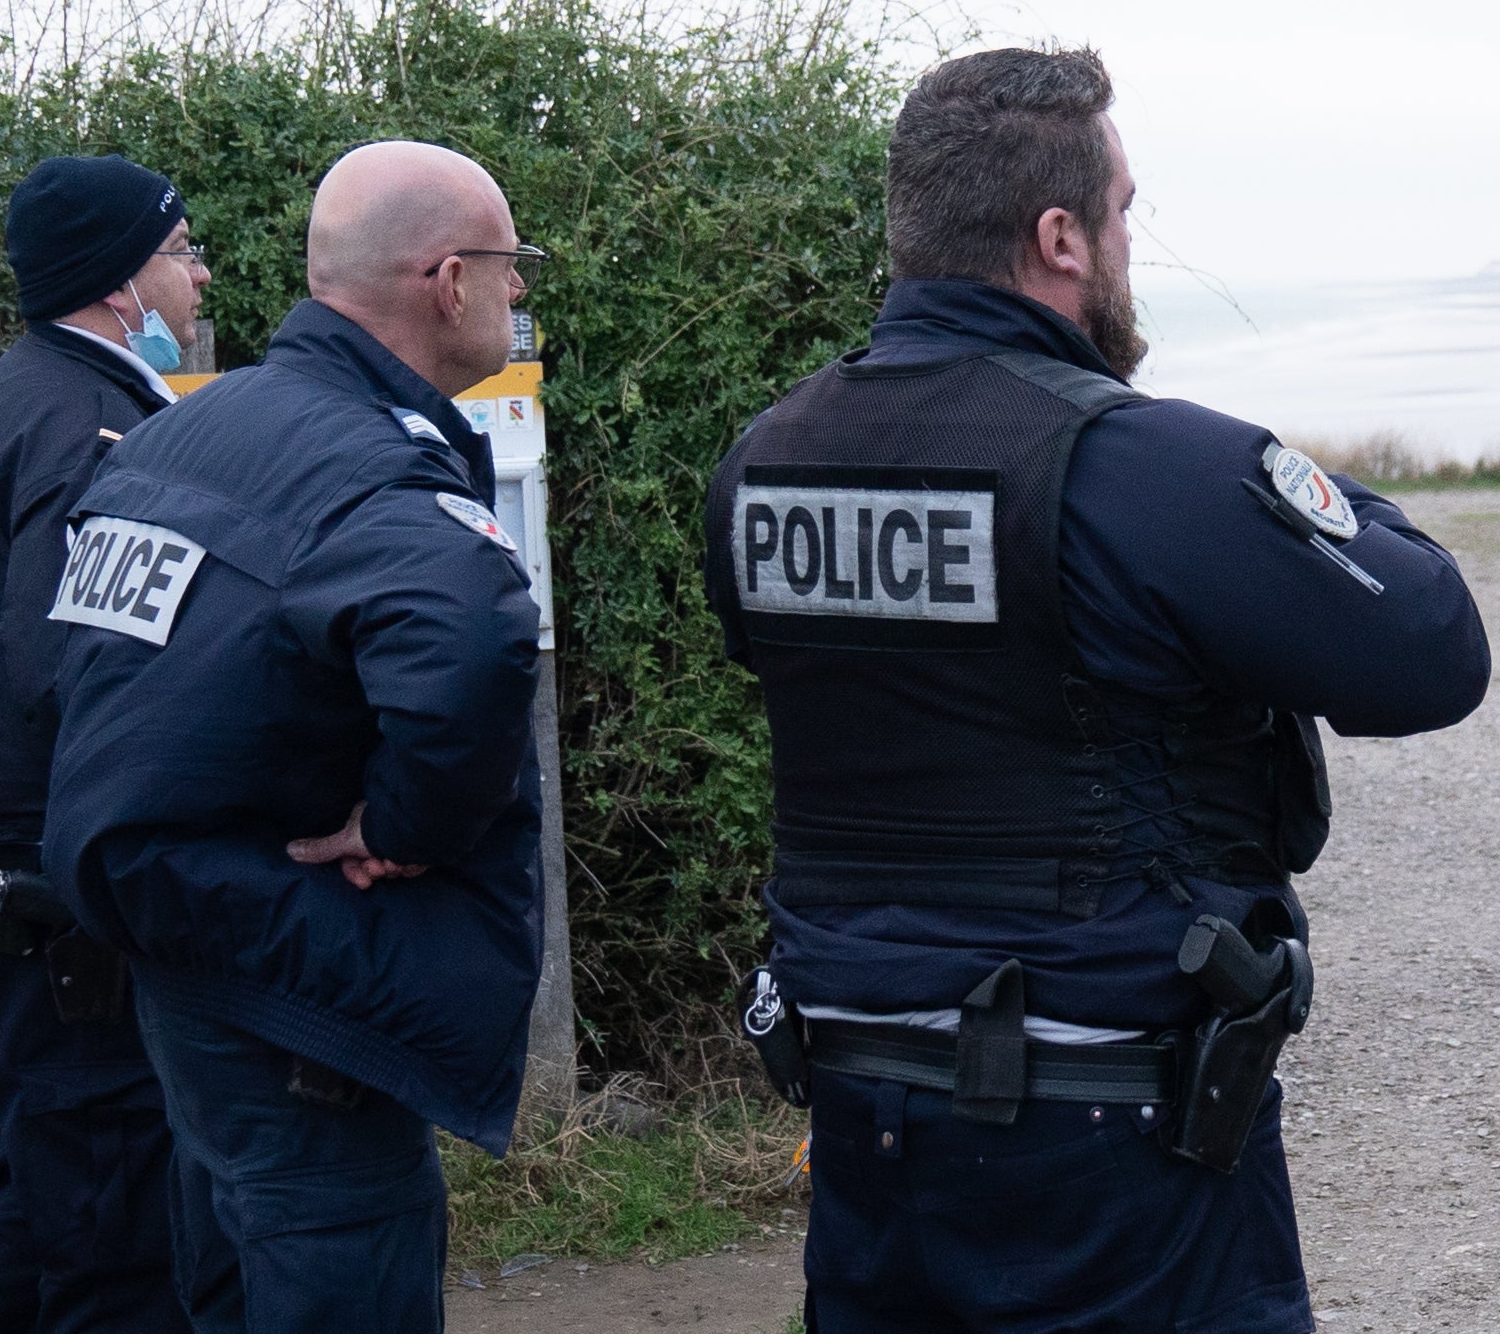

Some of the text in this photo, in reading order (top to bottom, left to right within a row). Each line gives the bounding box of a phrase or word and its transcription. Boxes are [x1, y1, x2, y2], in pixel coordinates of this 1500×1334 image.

[1280, 456, 1299, 479] POLICE
[57, 530, 190, 623] POLICE
[745, 503, 975, 603] POLICE
